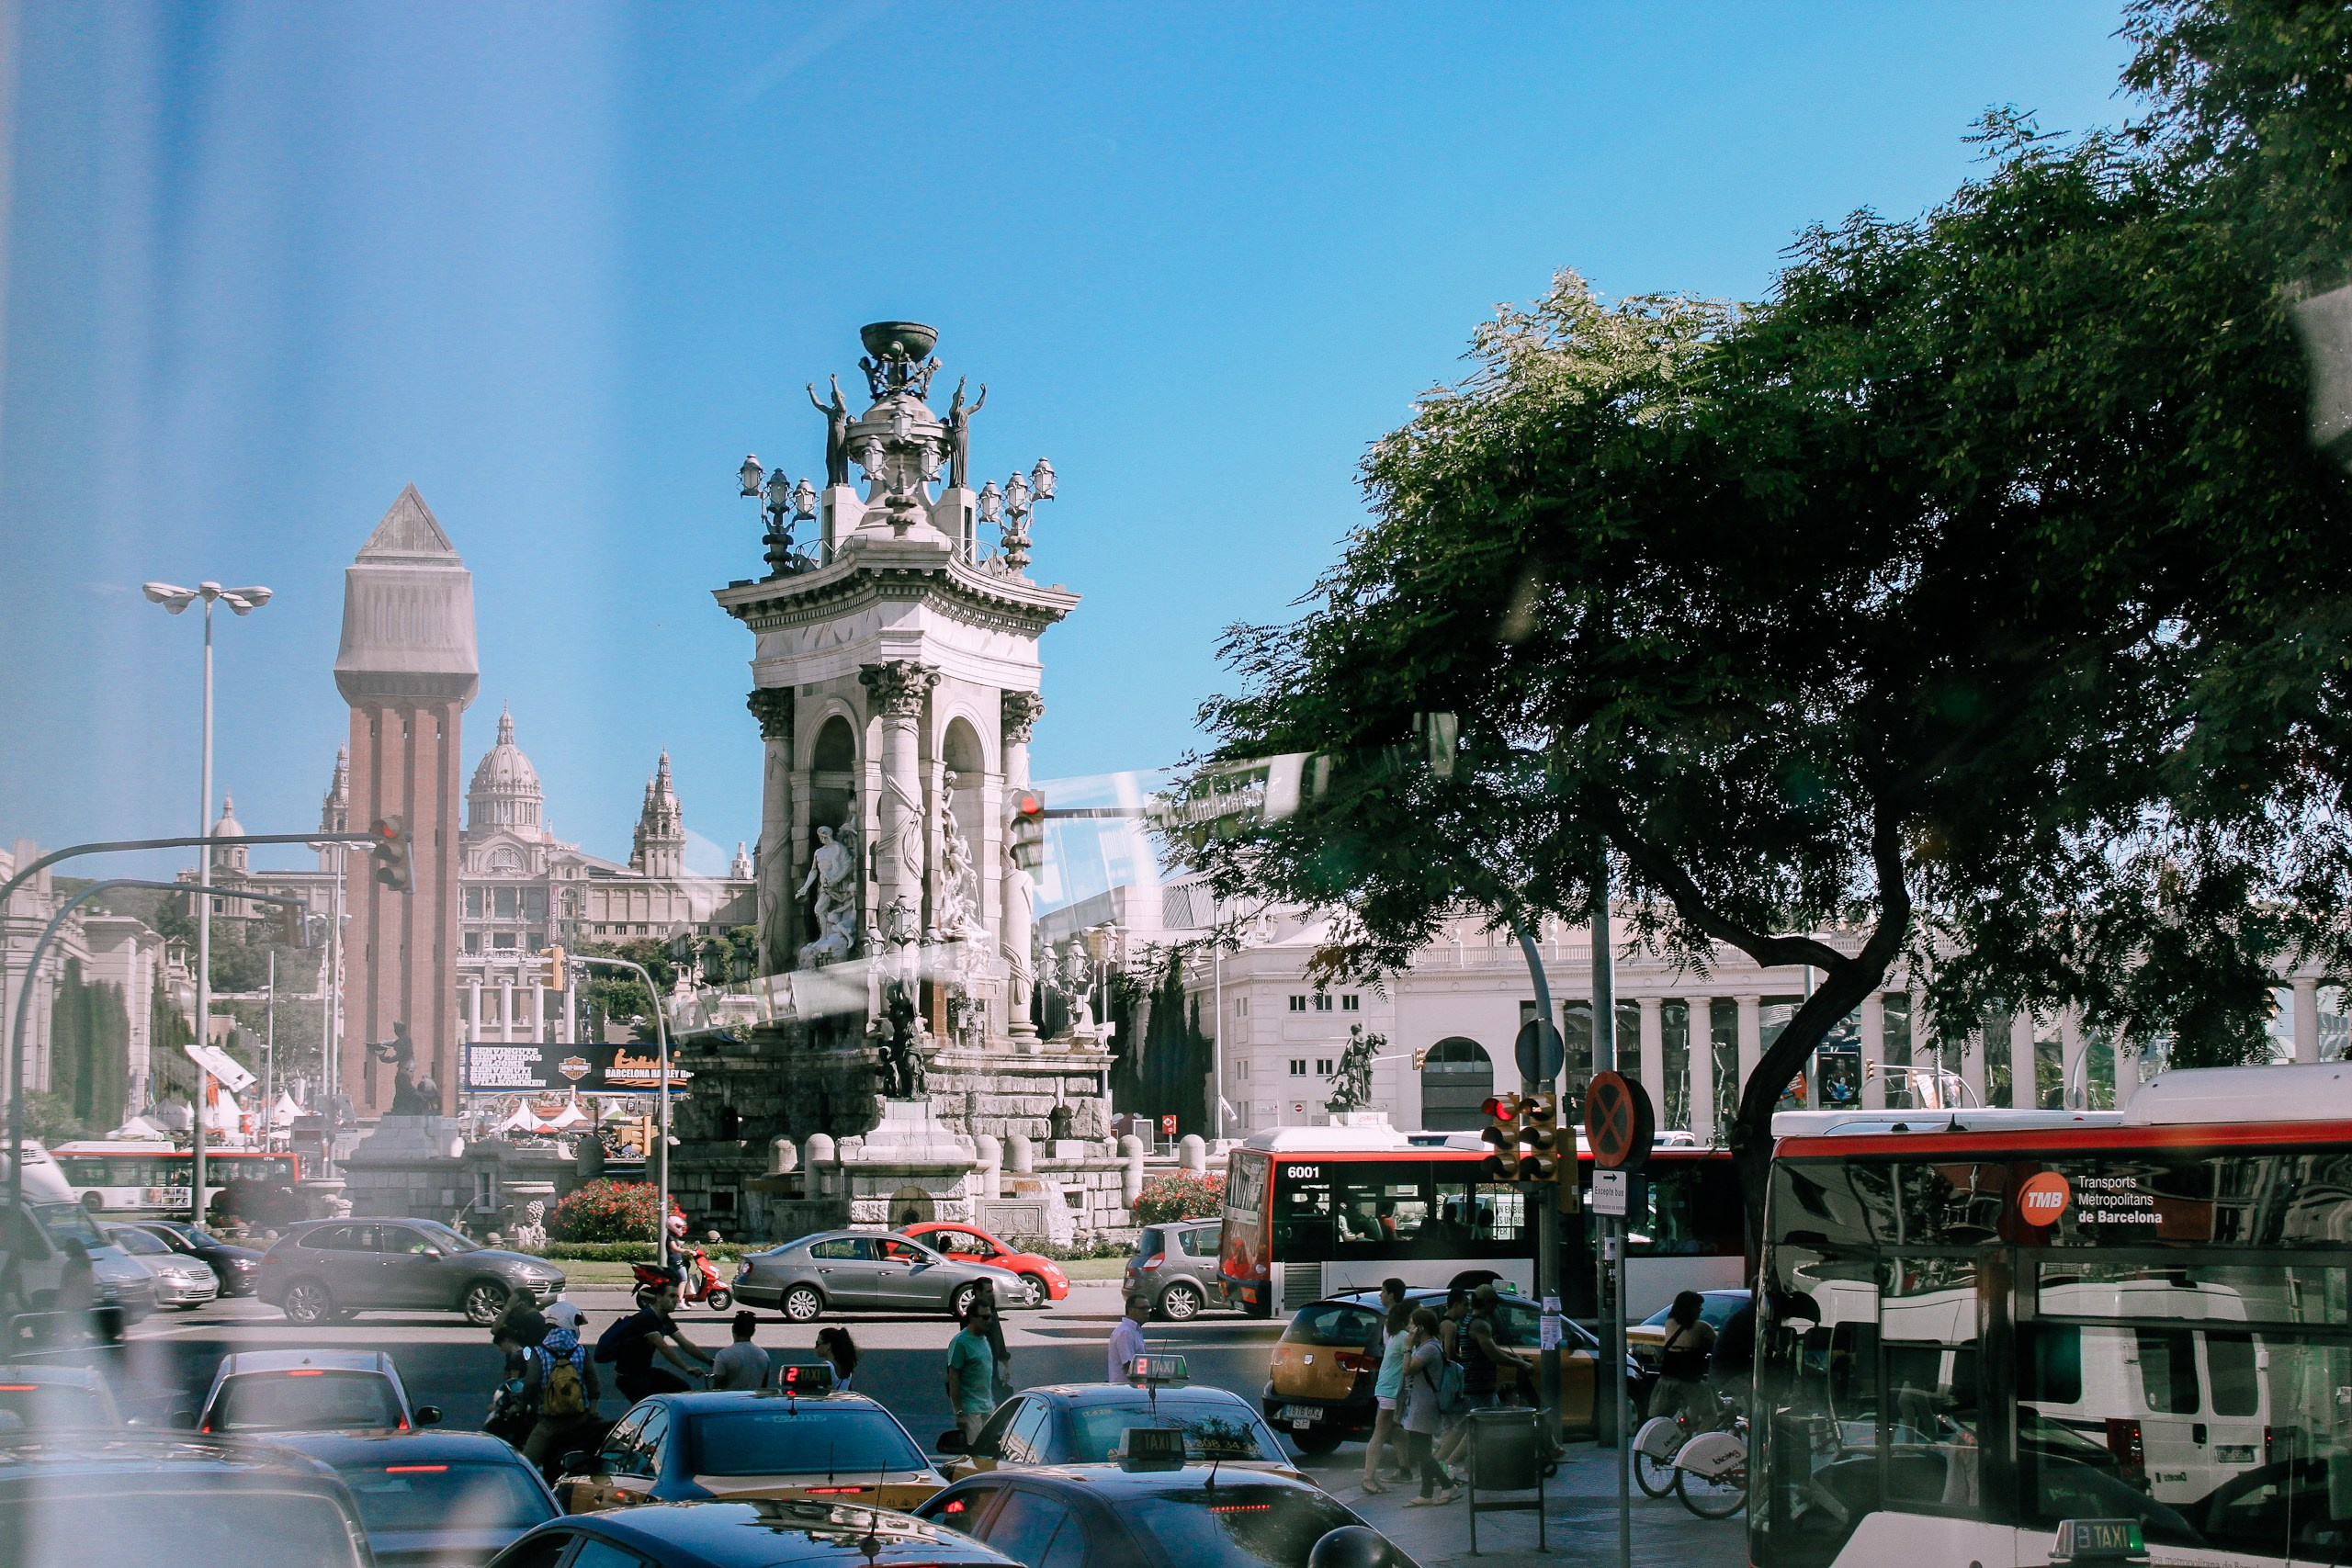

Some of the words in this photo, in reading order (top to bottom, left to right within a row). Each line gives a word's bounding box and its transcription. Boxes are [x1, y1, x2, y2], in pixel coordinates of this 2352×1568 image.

[605, 1068, 650, 1078] BARCELONA
[650, 1069, 679, 1078] HALEY
[1287, 1166, 1319, 1179] 6001
[2078, 1176, 2136, 1190] Transports
[1595, 1185, 1613, 1197] Excepte
[1614, 1188, 1624, 1196] bus
[2029, 1191, 2063, 1208] TMB
[2078, 1193, 2154, 1208] Metropolitans
[2078, 1211, 2094, 1223] de
[2098, 1211, 2163, 1224] Barcelona
[1137, 1359, 1148, 1374] 2
[1151, 1360, 1175, 1372] TAXI
[786, 1367, 798, 1382] 2
[800, 1368, 820, 1382] TAXI
[1145, 1433, 1170, 1450] TAXI
[2093, 1525, 2128, 1548] TAXI
